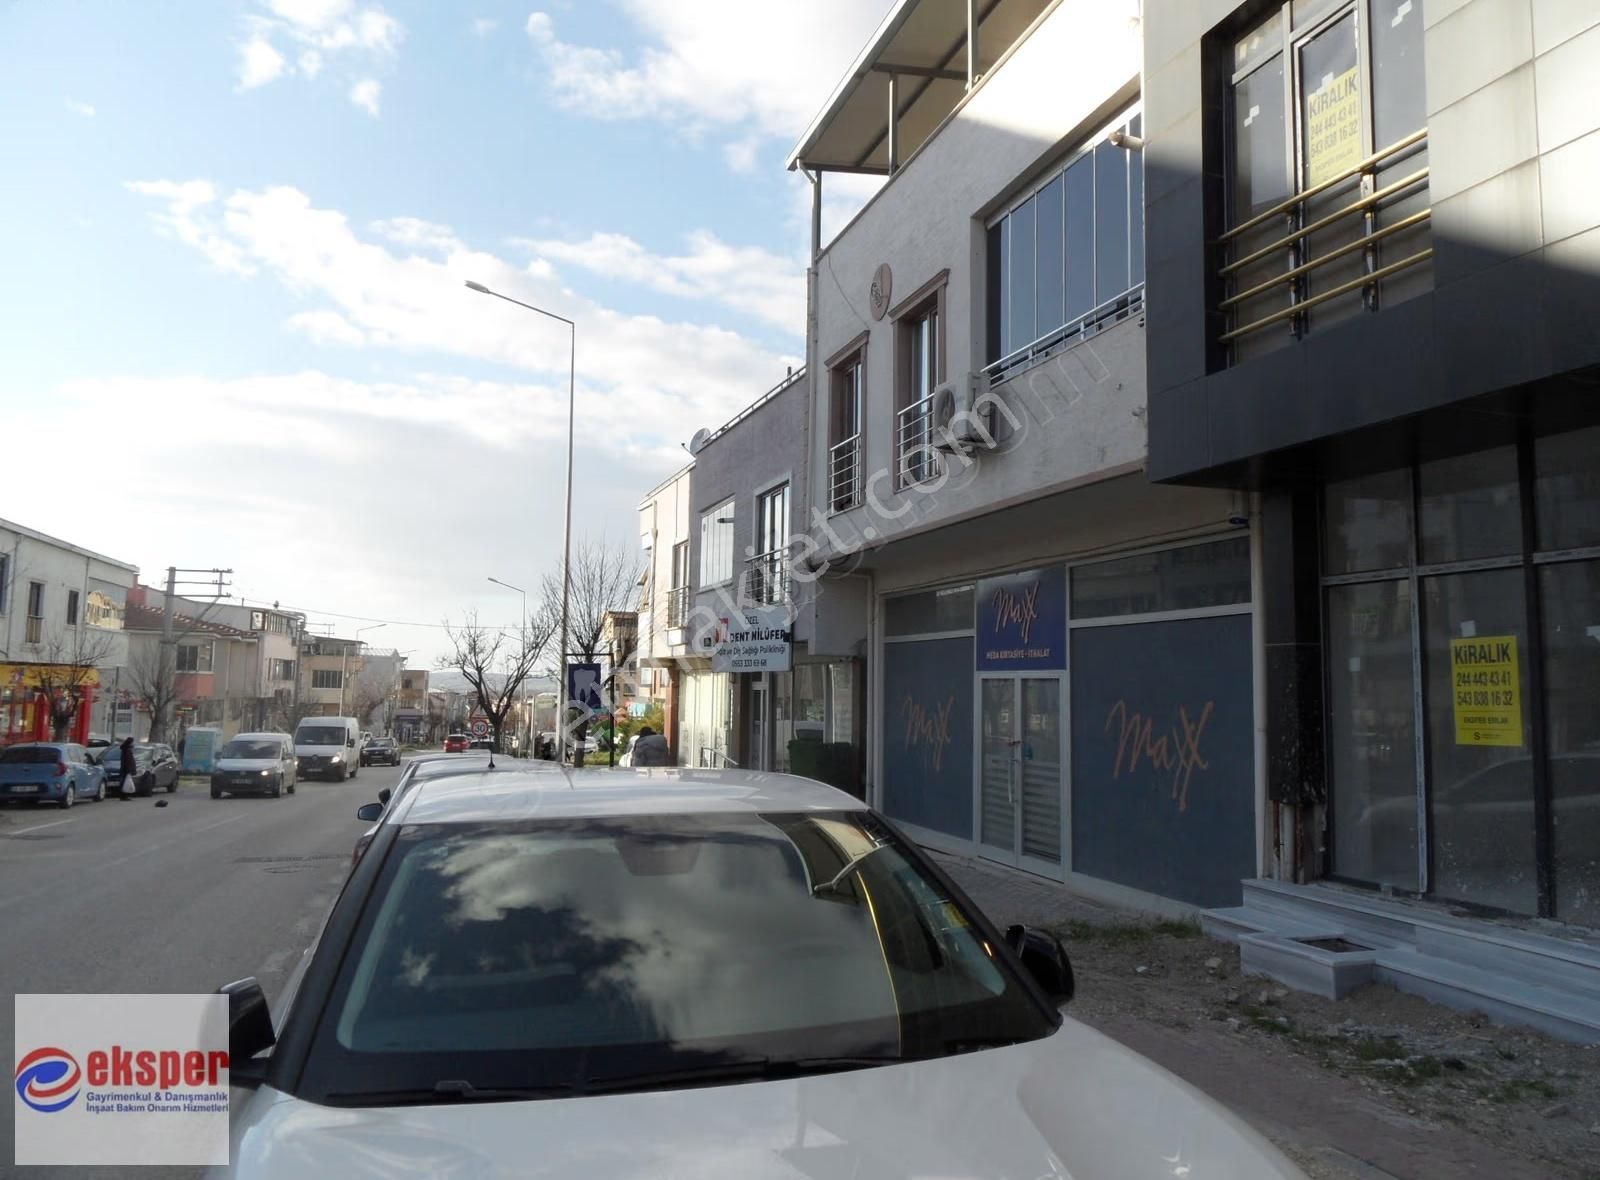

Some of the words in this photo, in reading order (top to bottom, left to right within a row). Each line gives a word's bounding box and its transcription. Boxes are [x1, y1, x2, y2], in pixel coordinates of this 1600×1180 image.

[751, 627, 786, 641] NİLÜFER
[1502, 671, 1511, 686] 41
[1502, 690, 1513, 706] 32
